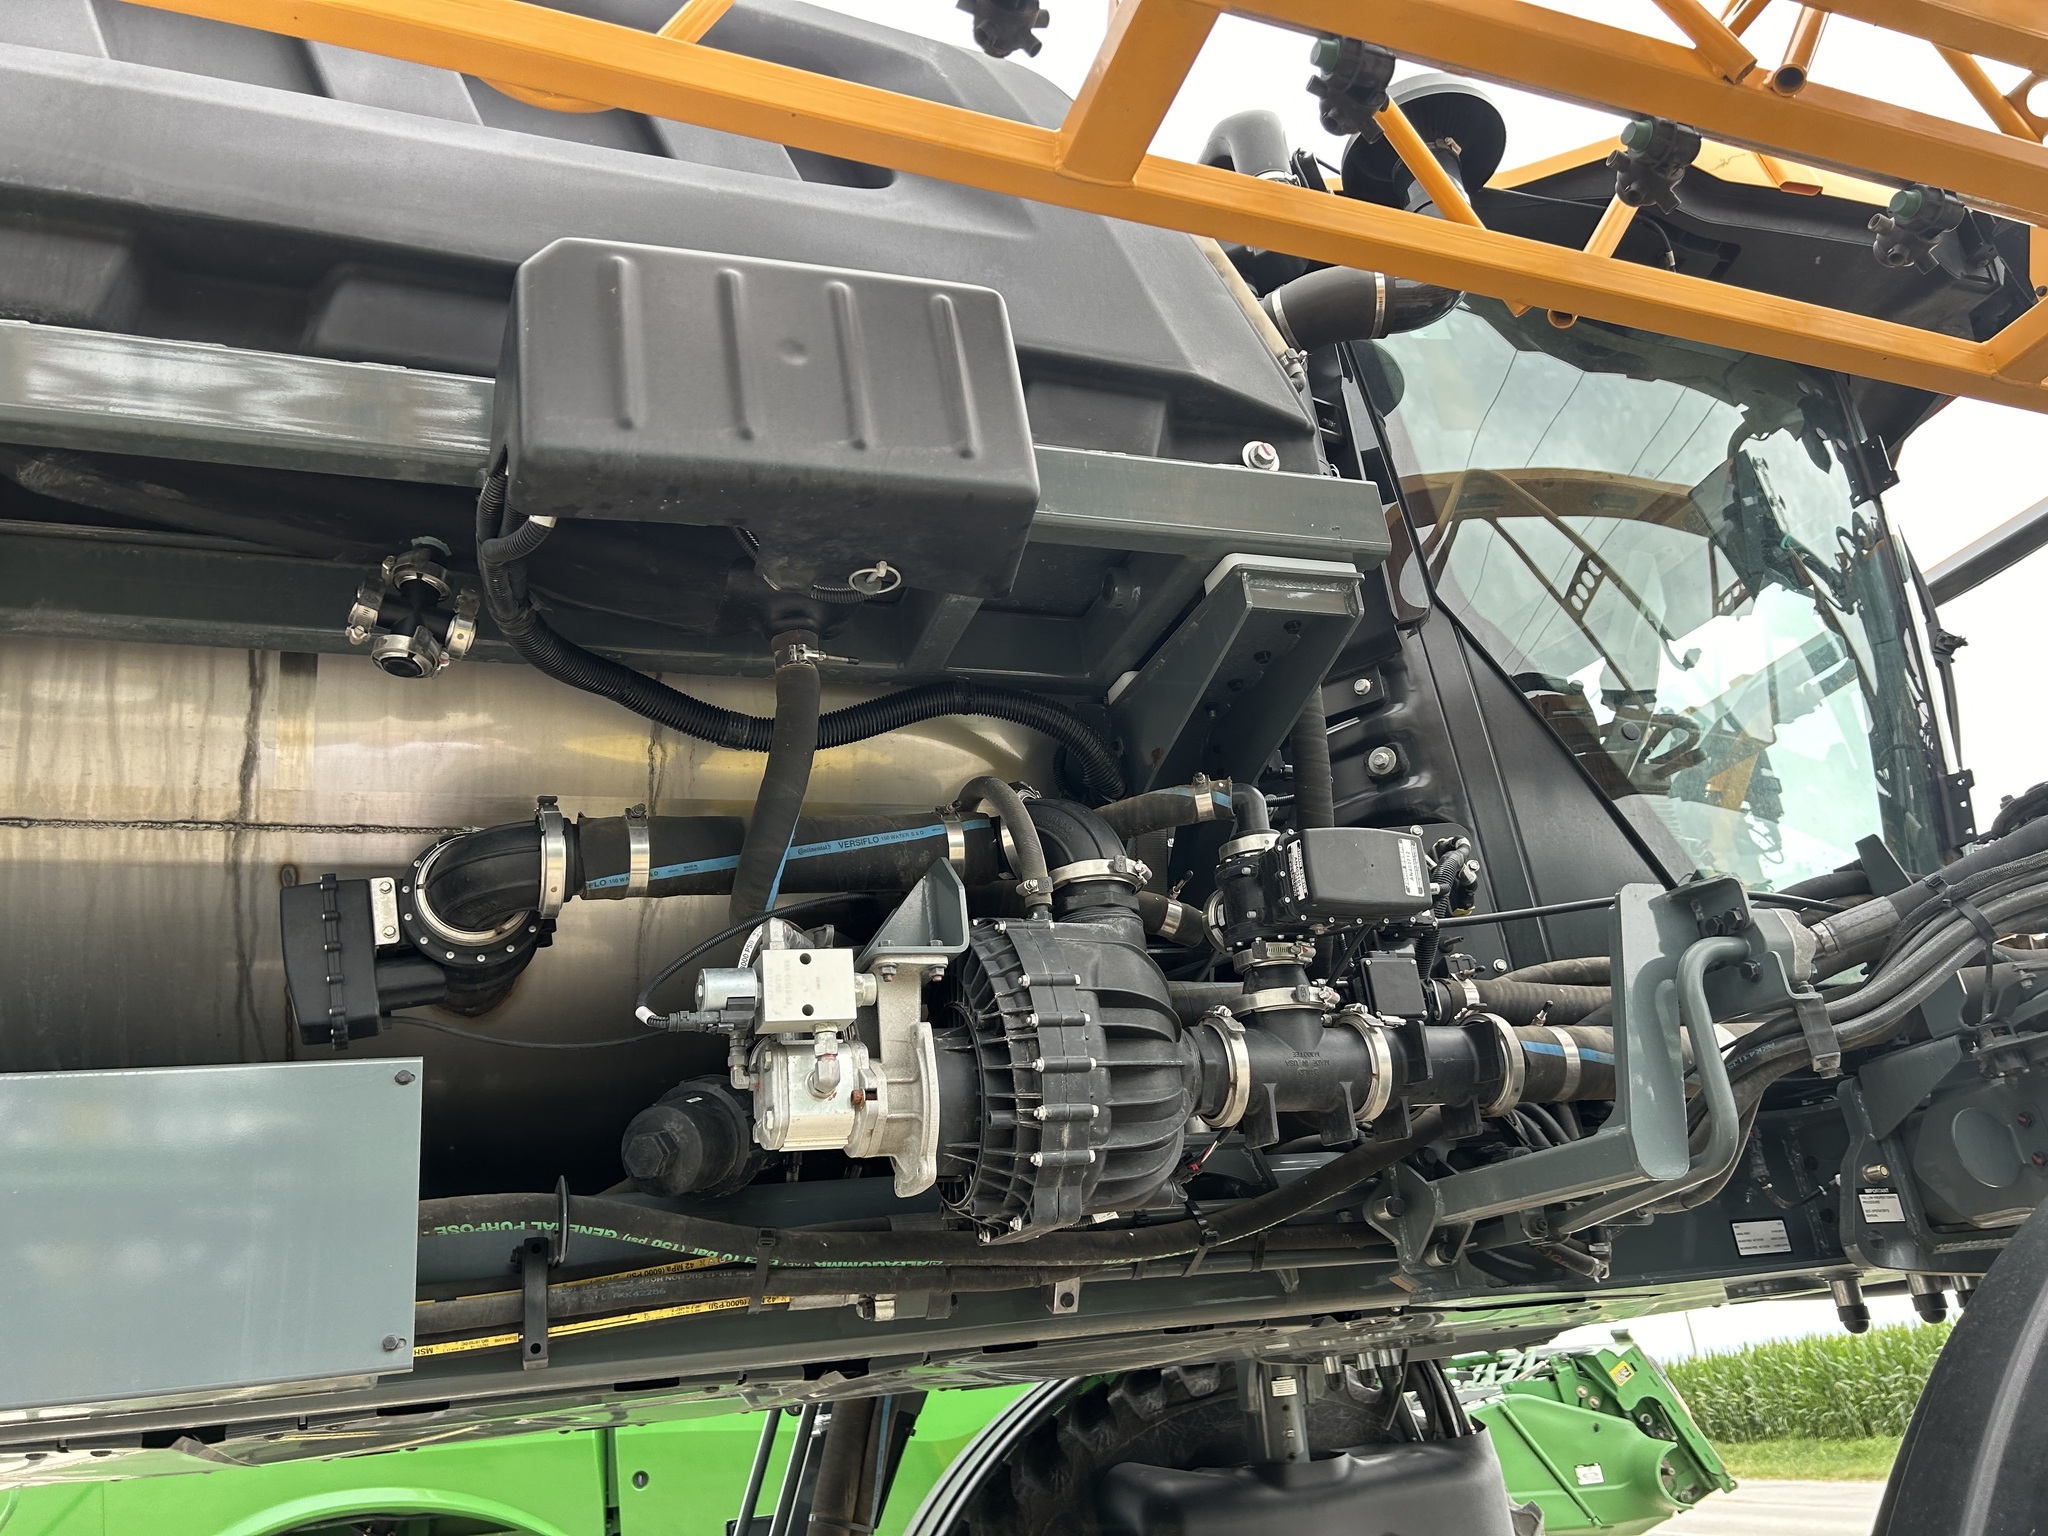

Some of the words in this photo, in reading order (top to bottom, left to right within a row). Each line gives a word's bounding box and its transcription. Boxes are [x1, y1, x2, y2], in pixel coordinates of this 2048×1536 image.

[838, 836, 880, 849] VERSIFLO
[890, 832, 910, 840] WATER
[434, 1221, 526, 1235] PURPOSE
[530, 1221, 617, 1239] GENEAL
[690, 1247, 719, 1258] bar
[666, 1263, 686, 1273] MPa
[413, 1347, 434, 1356] MSH
